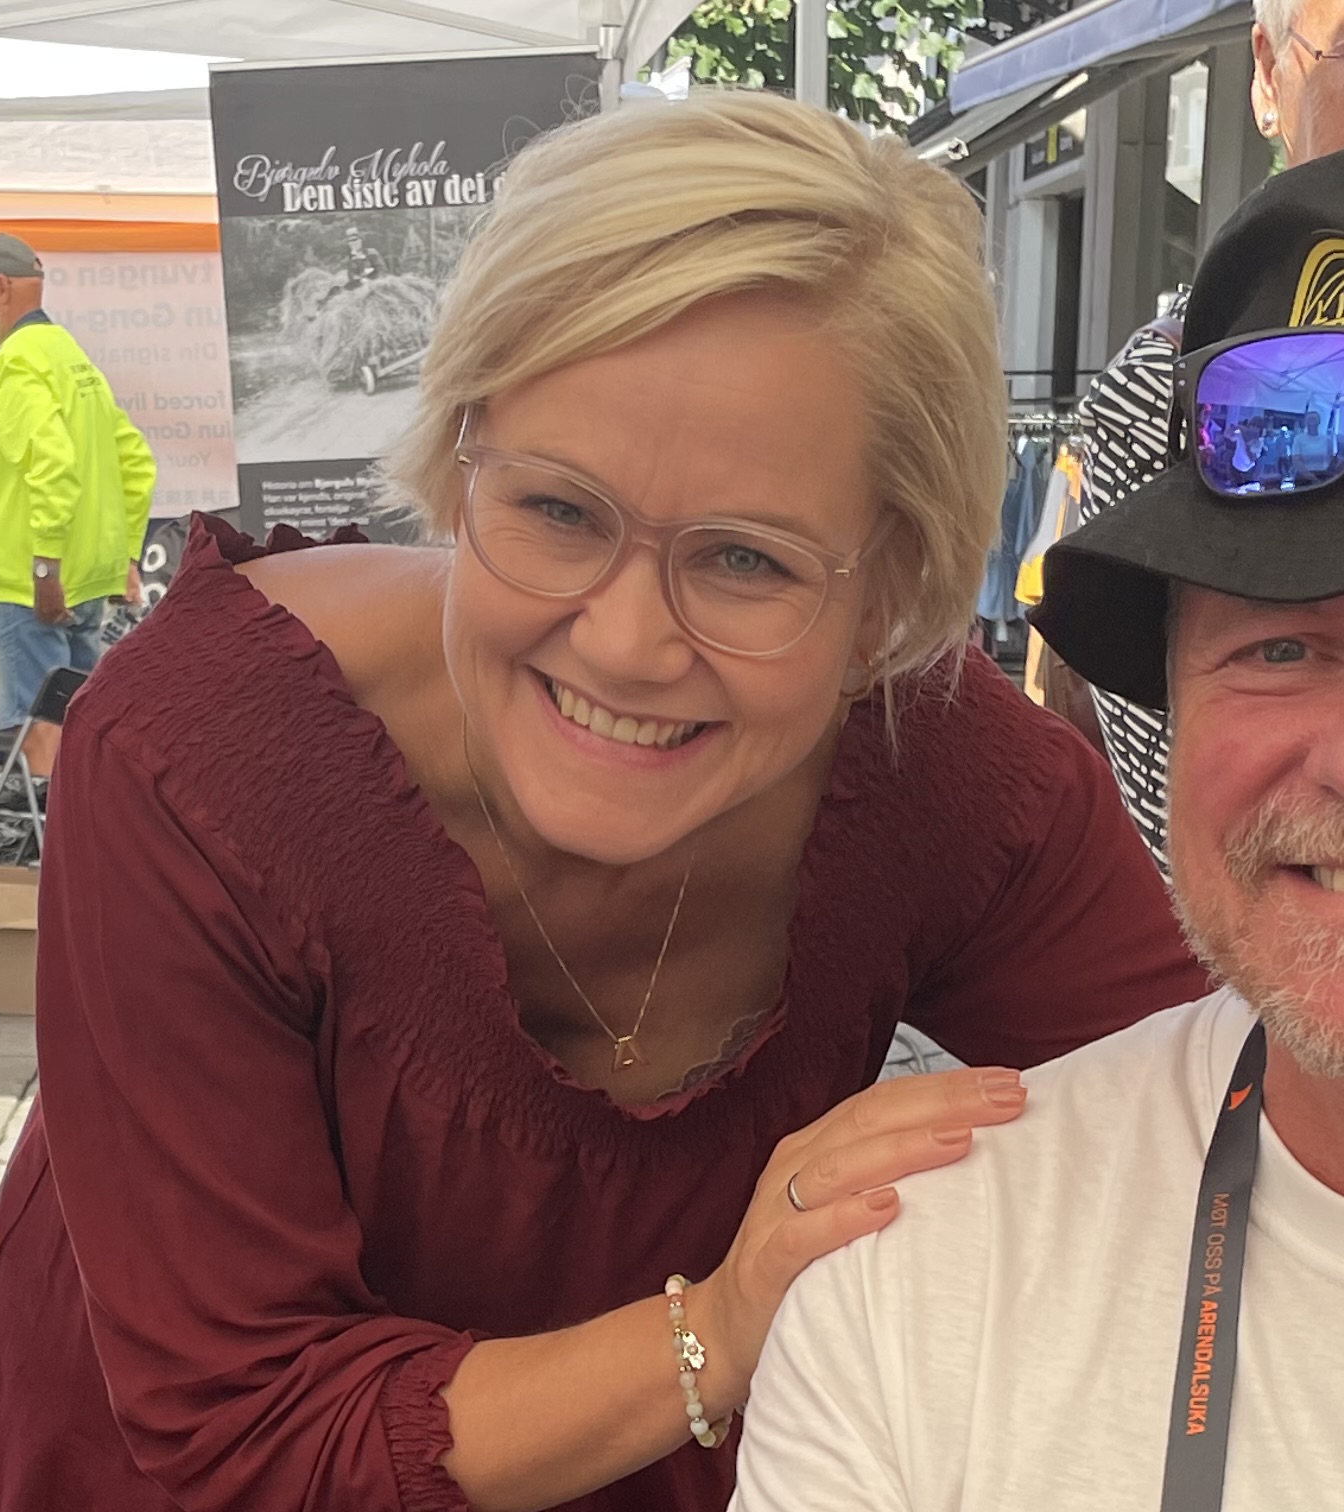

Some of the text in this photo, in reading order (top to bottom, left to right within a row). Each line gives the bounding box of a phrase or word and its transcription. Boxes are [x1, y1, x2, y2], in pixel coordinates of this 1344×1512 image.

[282, 182, 336, 212] Den
[341, 178, 400, 210] siste
[406, 178, 438, 207] av
[444, 172, 488, 205] dei
[1210, 1192, 1231, 1229] MØT
[1204, 1232, 1226, 1271] OSS
[1186, 1300, 1219, 1436] ARENDALSUKA
